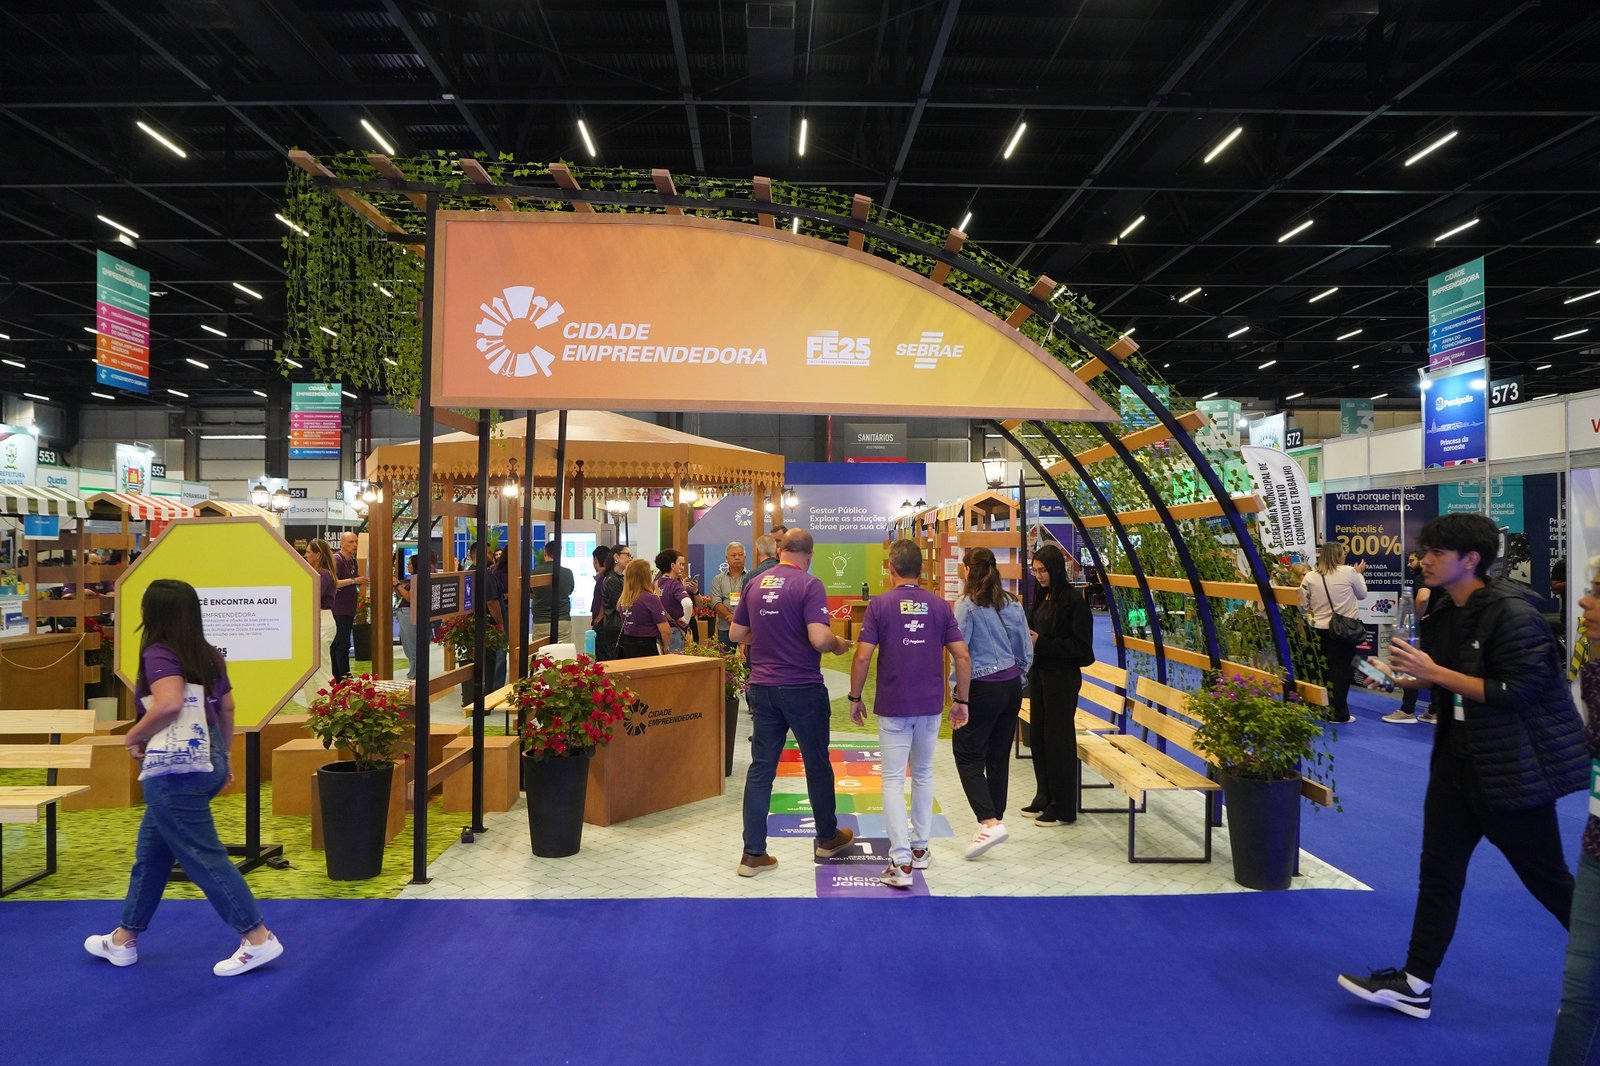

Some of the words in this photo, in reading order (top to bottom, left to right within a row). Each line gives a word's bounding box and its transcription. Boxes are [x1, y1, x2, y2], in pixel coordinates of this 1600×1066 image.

[1444, 268, 1465, 281] CIDADE
[1432, 273, 1480, 297] EMPREENDEDORA
[1441, 320, 1466, 332] ATENDIMENTO
[1466, 315, 1481, 324] SEBRAE
[562, 322, 651, 340] CIDADE
[806, 336, 871, 360] FE25
[1442, 337, 1471, 350] CONHECIMENTO
[562, 344, 768, 365] EMPREENDEDORA
[896, 344, 964, 358] SEBRAE
[1492, 382, 1519, 404] 573
[1444, 394, 1473, 407] Penápolis
[857, 432, 894, 442] SANITÁRIOS
[1286, 432, 1301, 447] 572
[1443, 443, 1466, 452] noroeste
[39, 449, 56, 463] 553
[152, 465, 165, 477] 552
[1258, 462, 1268, 472] DE
[47, 476, 68, 486] Quatá
[1283, 465, 1300, 498] TRABALHO
[1336, 492, 1355, 500] vida
[1357, 493, 1390, 502] porque
[810, 515, 840, 524] Explore
[852, 515, 886, 523] soluções
[1276, 484, 1294, 546] DESENVOLVIMENTO
[324, 532, 336, 540] SEJA
[1336, 525, 1376, 534] Penápolis
[1336, 535, 1402, 556] 300%
[760, 576, 785, 586] FE25
[900, 601, 928, 612] FE25
[648, 708, 672, 719] CIDADE
[648, 712, 703, 727] EMPREENDEDORA
[854, 842, 872, 854] 1
